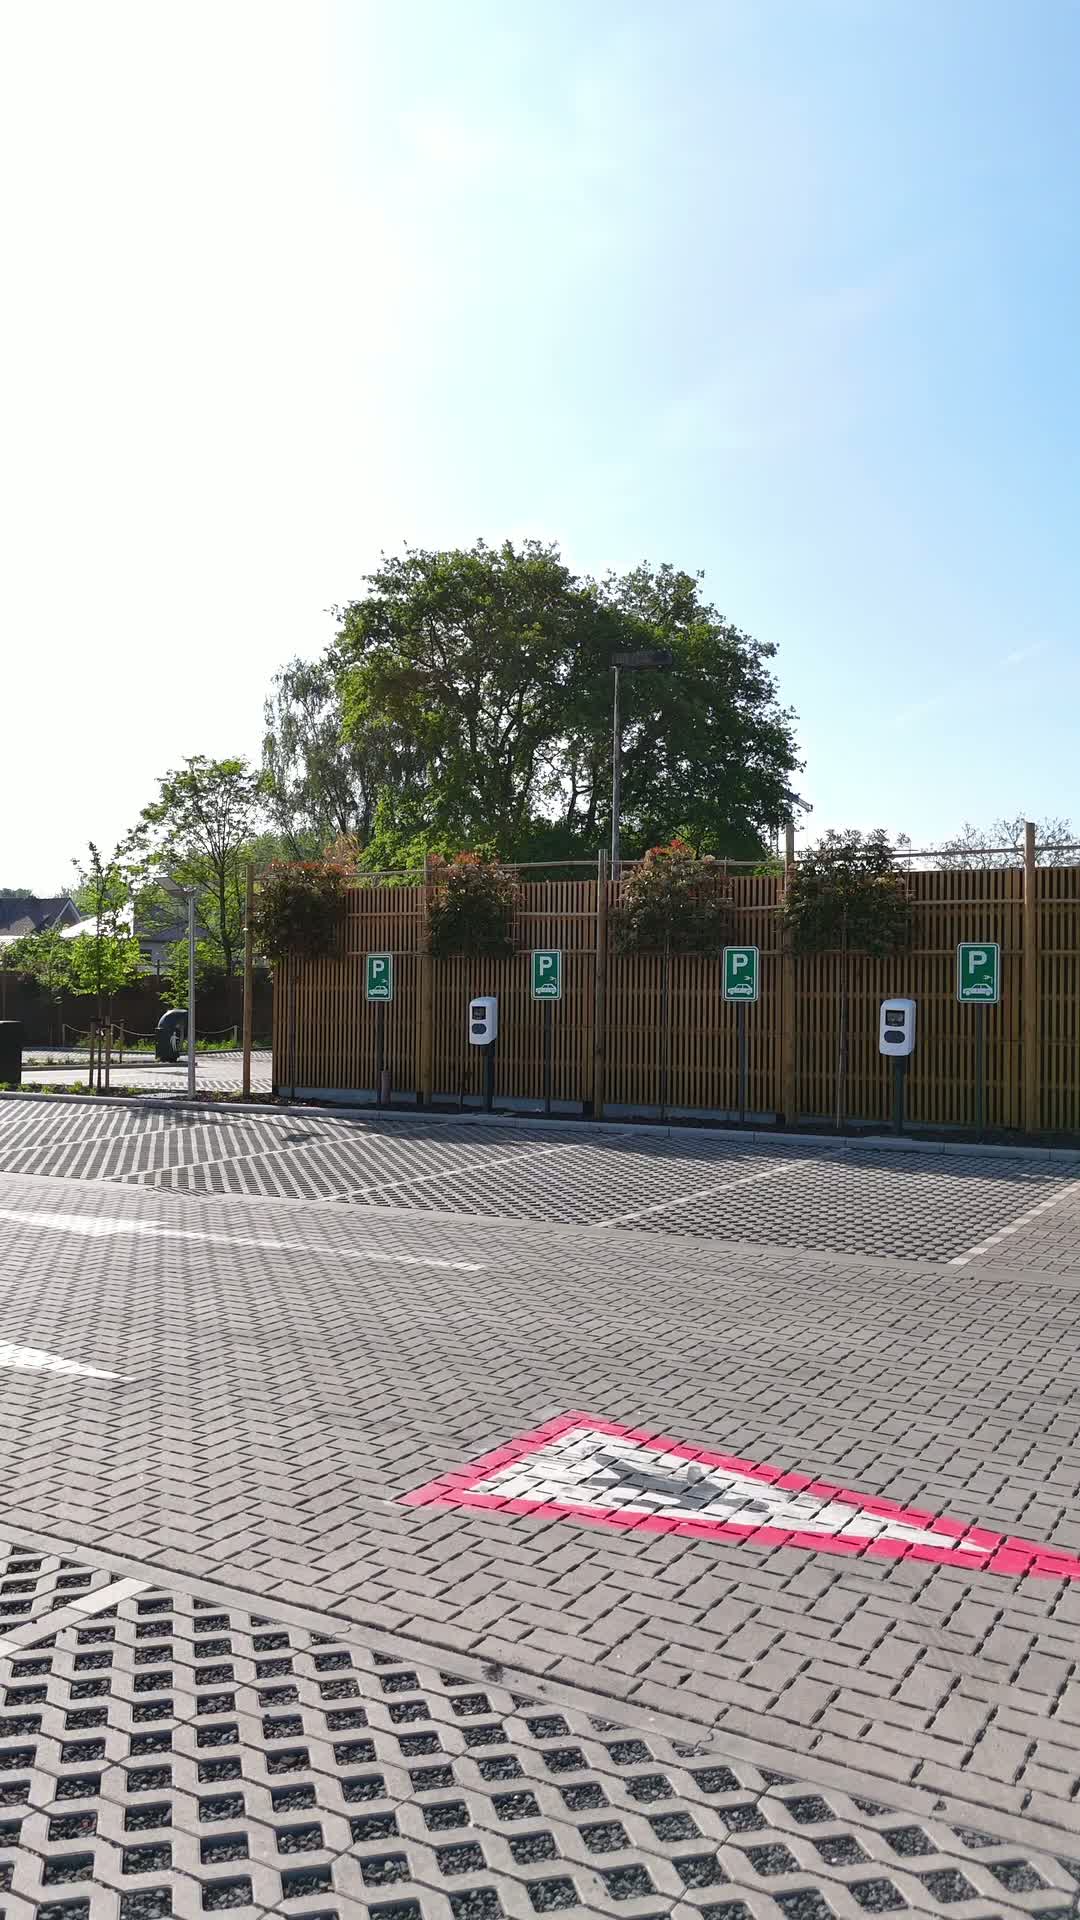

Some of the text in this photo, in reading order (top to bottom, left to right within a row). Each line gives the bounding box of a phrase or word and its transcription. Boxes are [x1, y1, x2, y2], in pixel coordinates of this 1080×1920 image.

[373, 959, 385, 979] P
[539, 956, 552, 976] P
[732, 953, 748, 975] P
[968, 950, 987, 974] P
